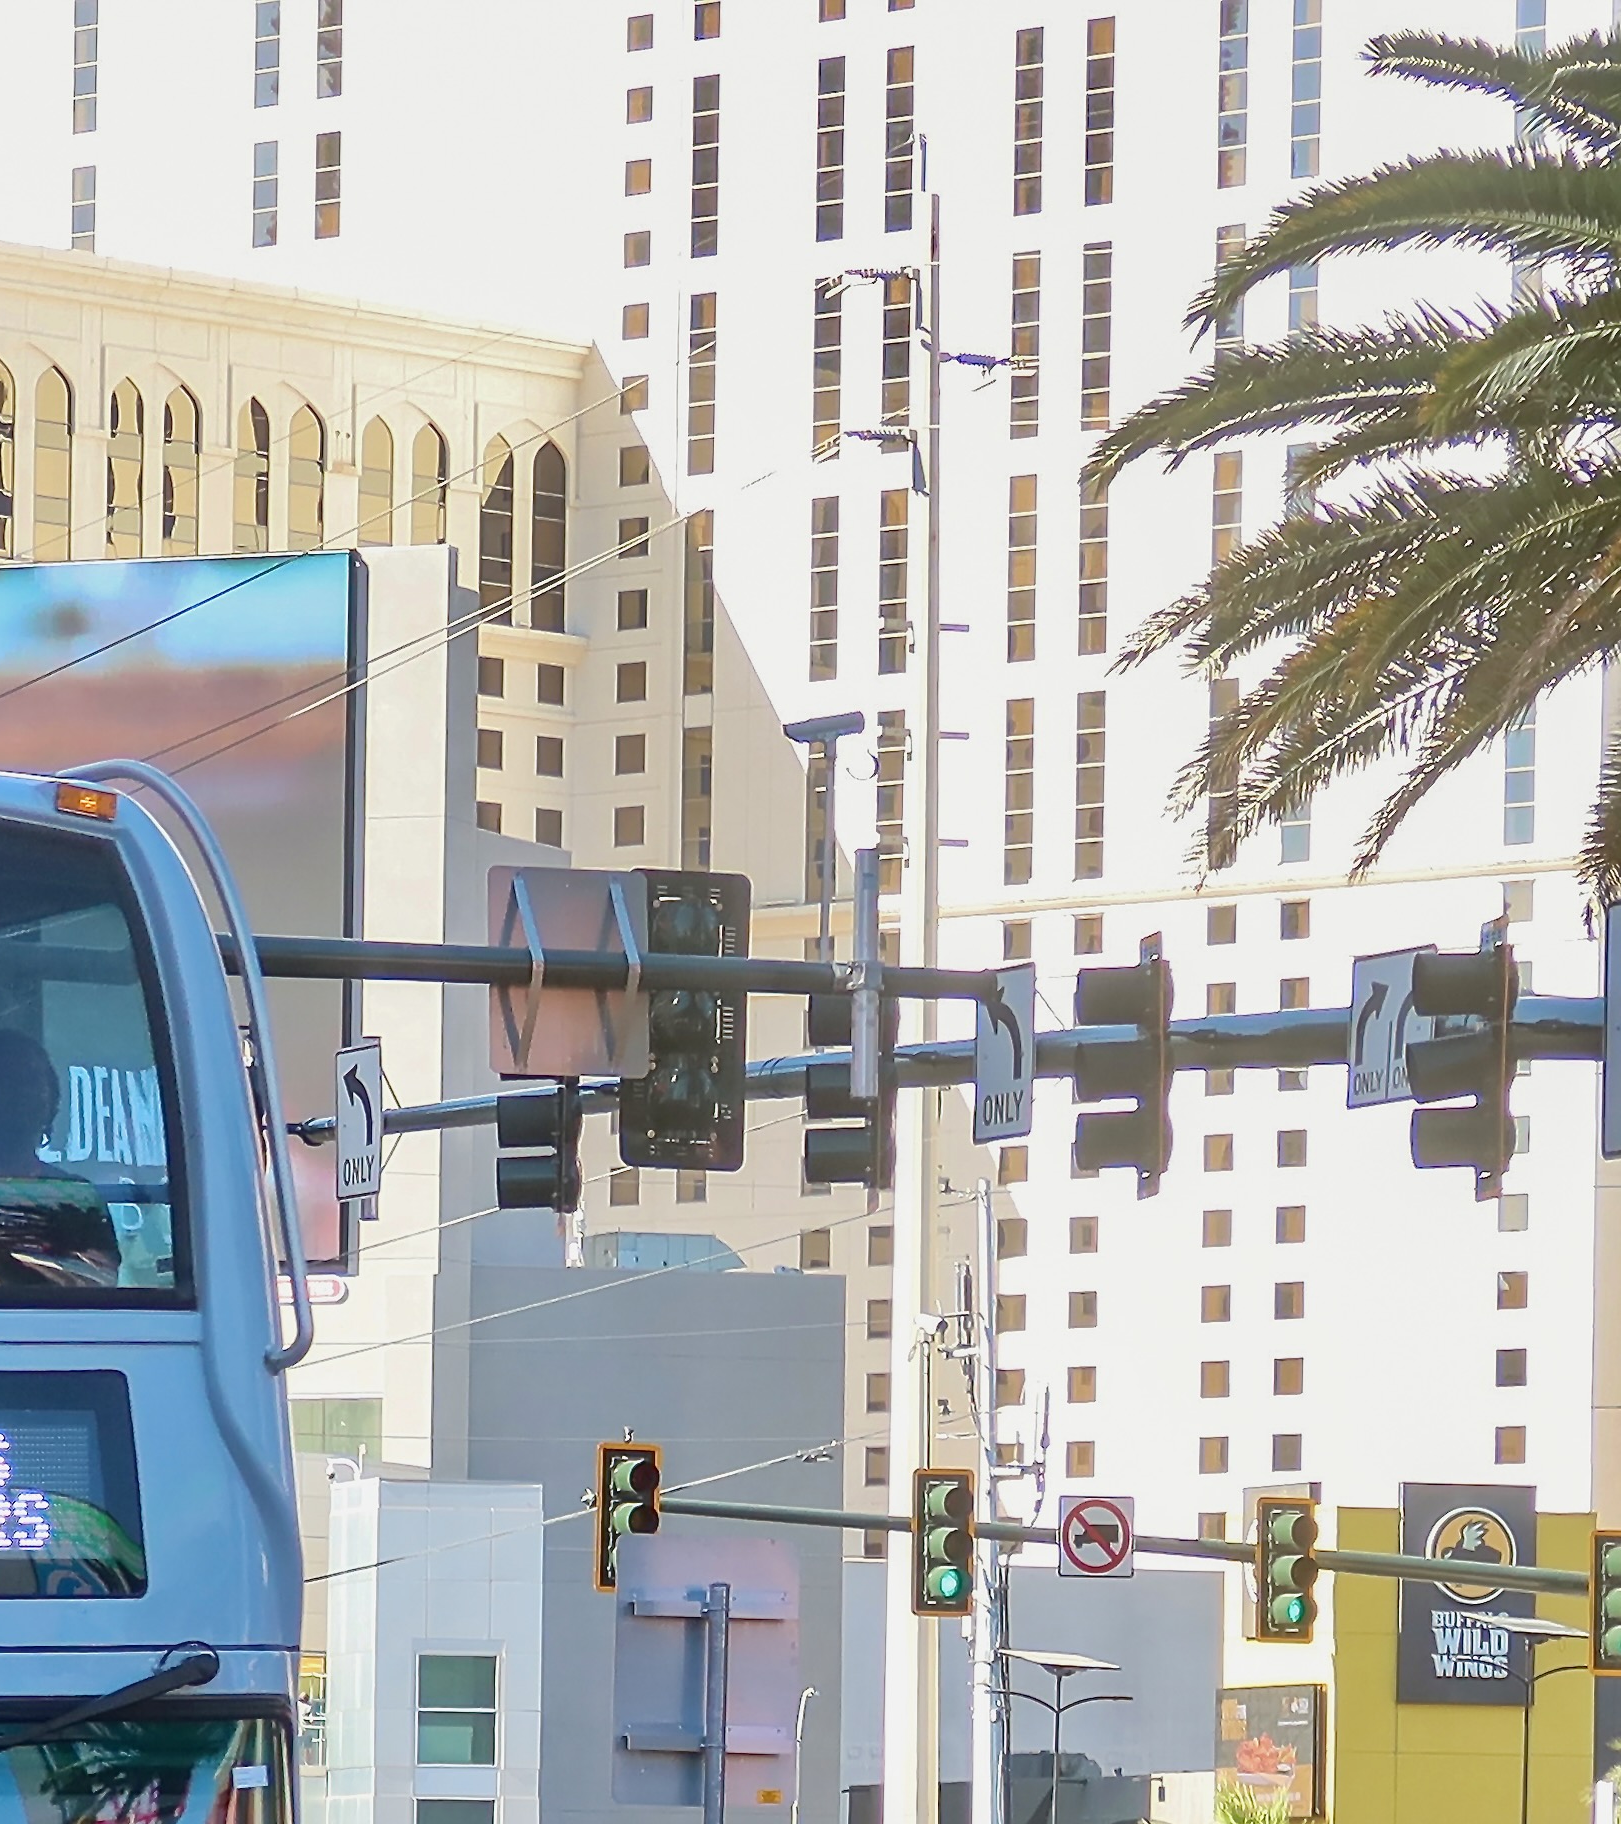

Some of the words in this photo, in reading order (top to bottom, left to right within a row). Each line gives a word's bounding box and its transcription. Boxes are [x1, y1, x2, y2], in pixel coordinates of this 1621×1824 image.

[1354, 1068, 1385, 1096] ONLY
[1393, 1066, 1410, 1090] ON
[982, 1091, 1025, 1128] ONLY
[343, 1152, 376, 1187] ONLY
[1431, 1627, 1509, 1656] WILD
[1431, 1653, 1509, 1679] WINGS
